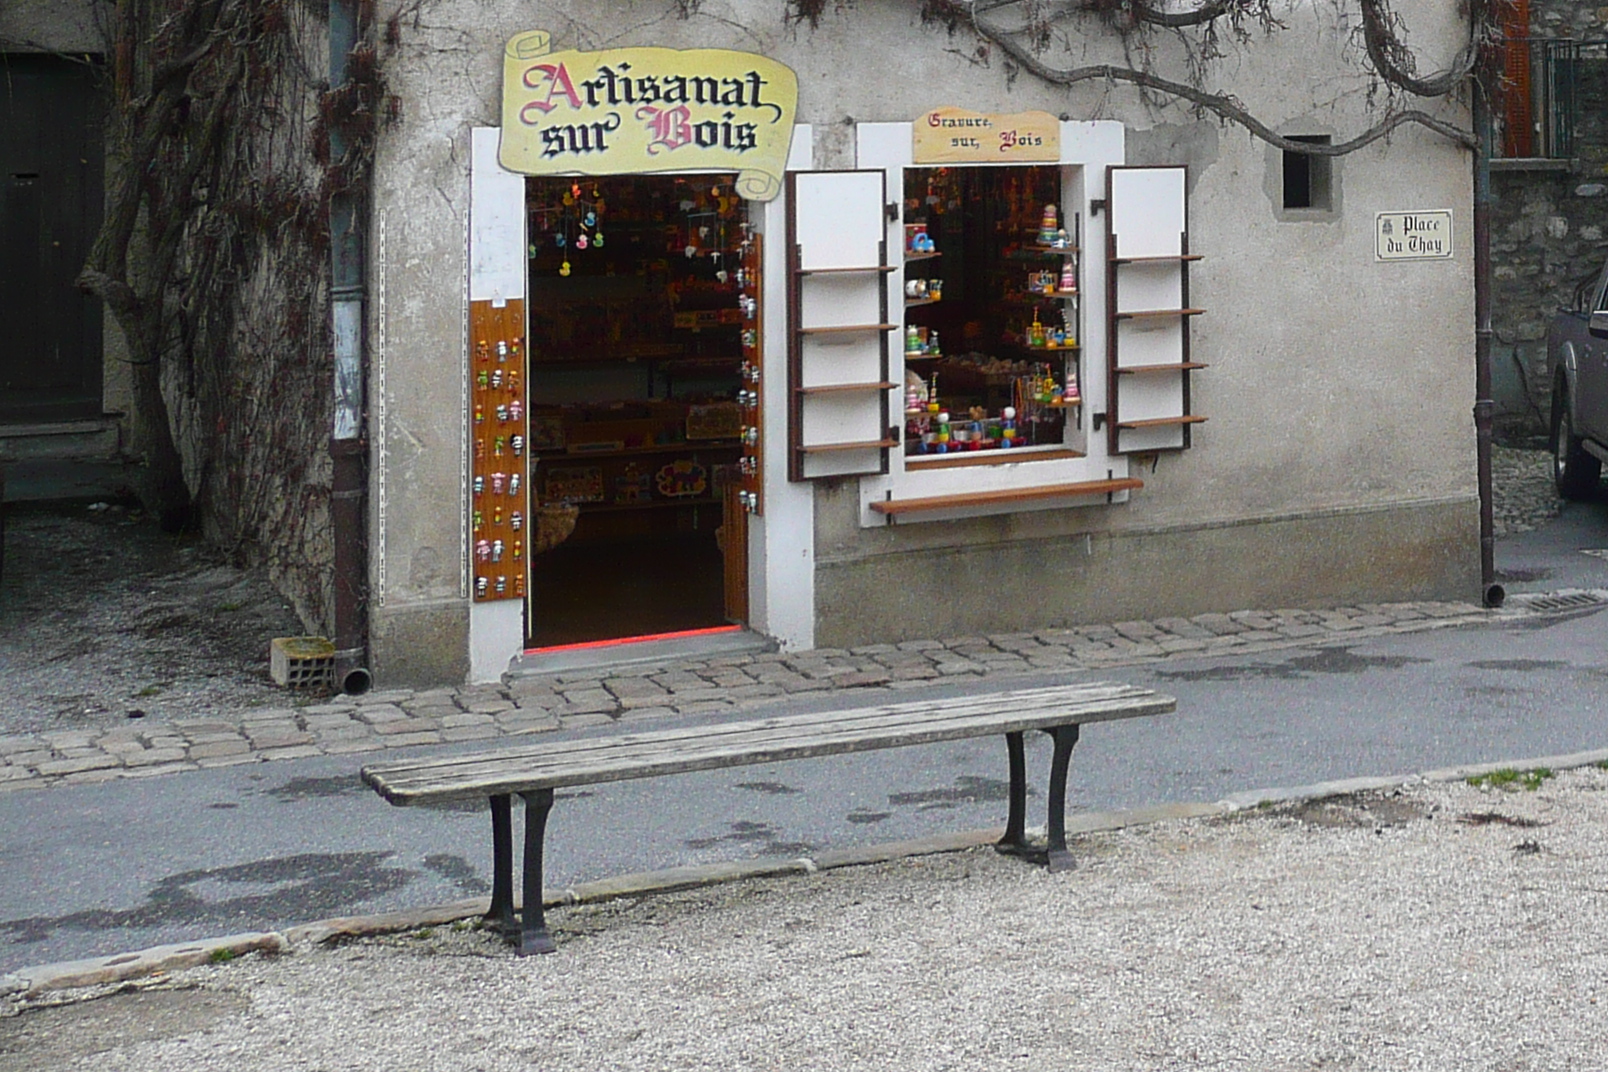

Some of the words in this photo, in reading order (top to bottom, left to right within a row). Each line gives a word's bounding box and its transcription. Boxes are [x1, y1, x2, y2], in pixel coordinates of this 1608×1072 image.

[520, 61, 782, 125] Artisanat
[539, 112, 621, 158] sur
[635, 104, 759, 156] Bois
[999, 129, 1043, 153] Bois
[1403, 215, 1440, 236] Place
[1387, 237, 1403, 253] du
